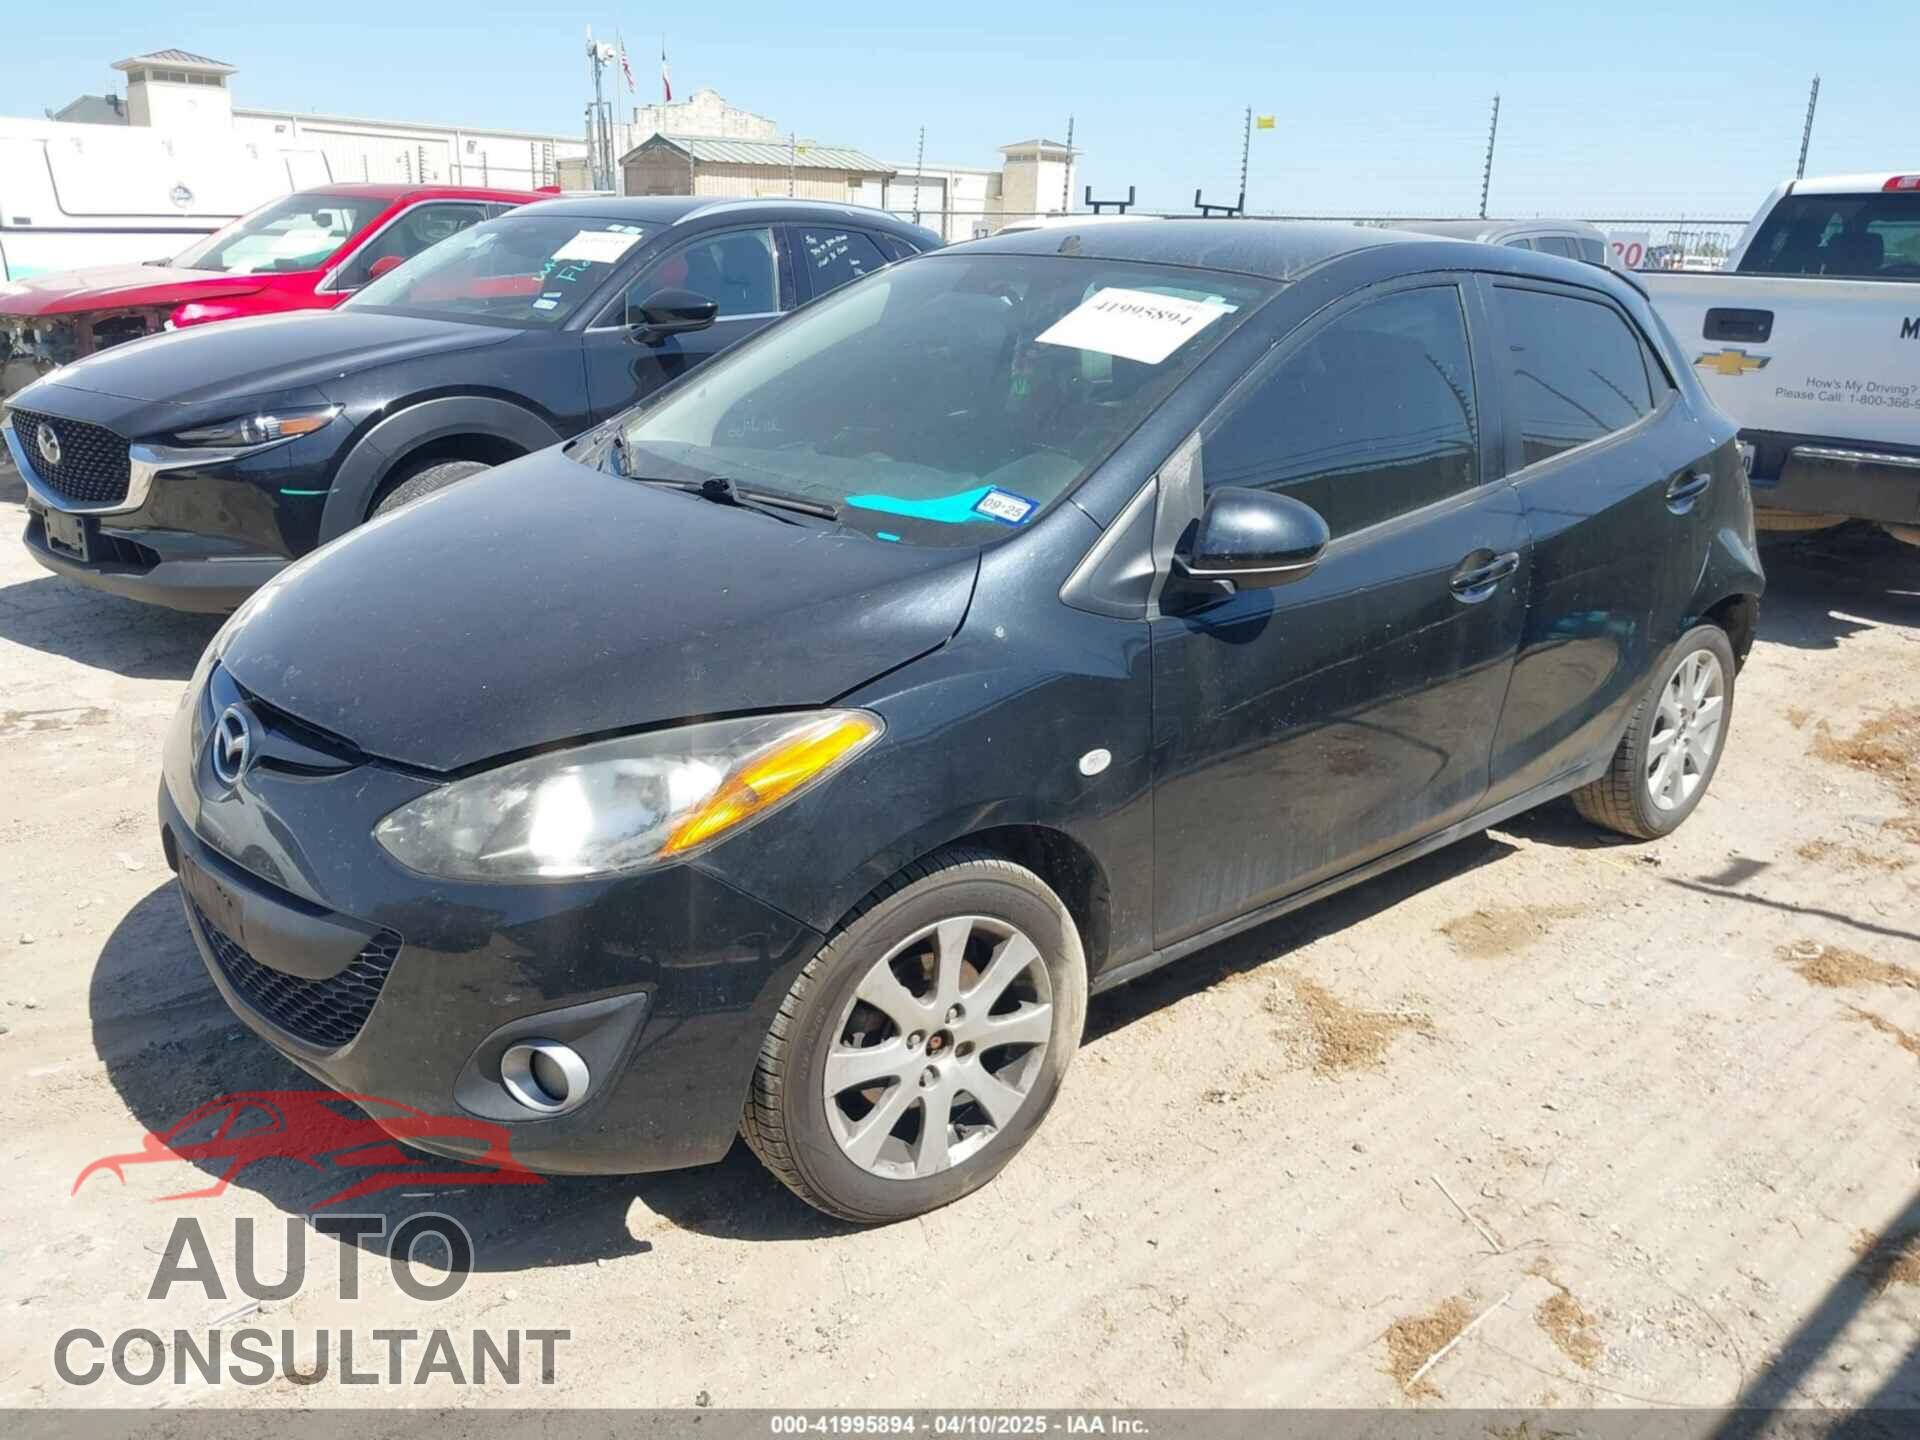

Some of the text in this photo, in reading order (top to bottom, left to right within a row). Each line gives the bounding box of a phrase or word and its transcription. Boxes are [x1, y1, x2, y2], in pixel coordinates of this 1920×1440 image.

[1775, 387, 1815, 400] Please
[1806, 377, 1918, 397] How's My Driving?
